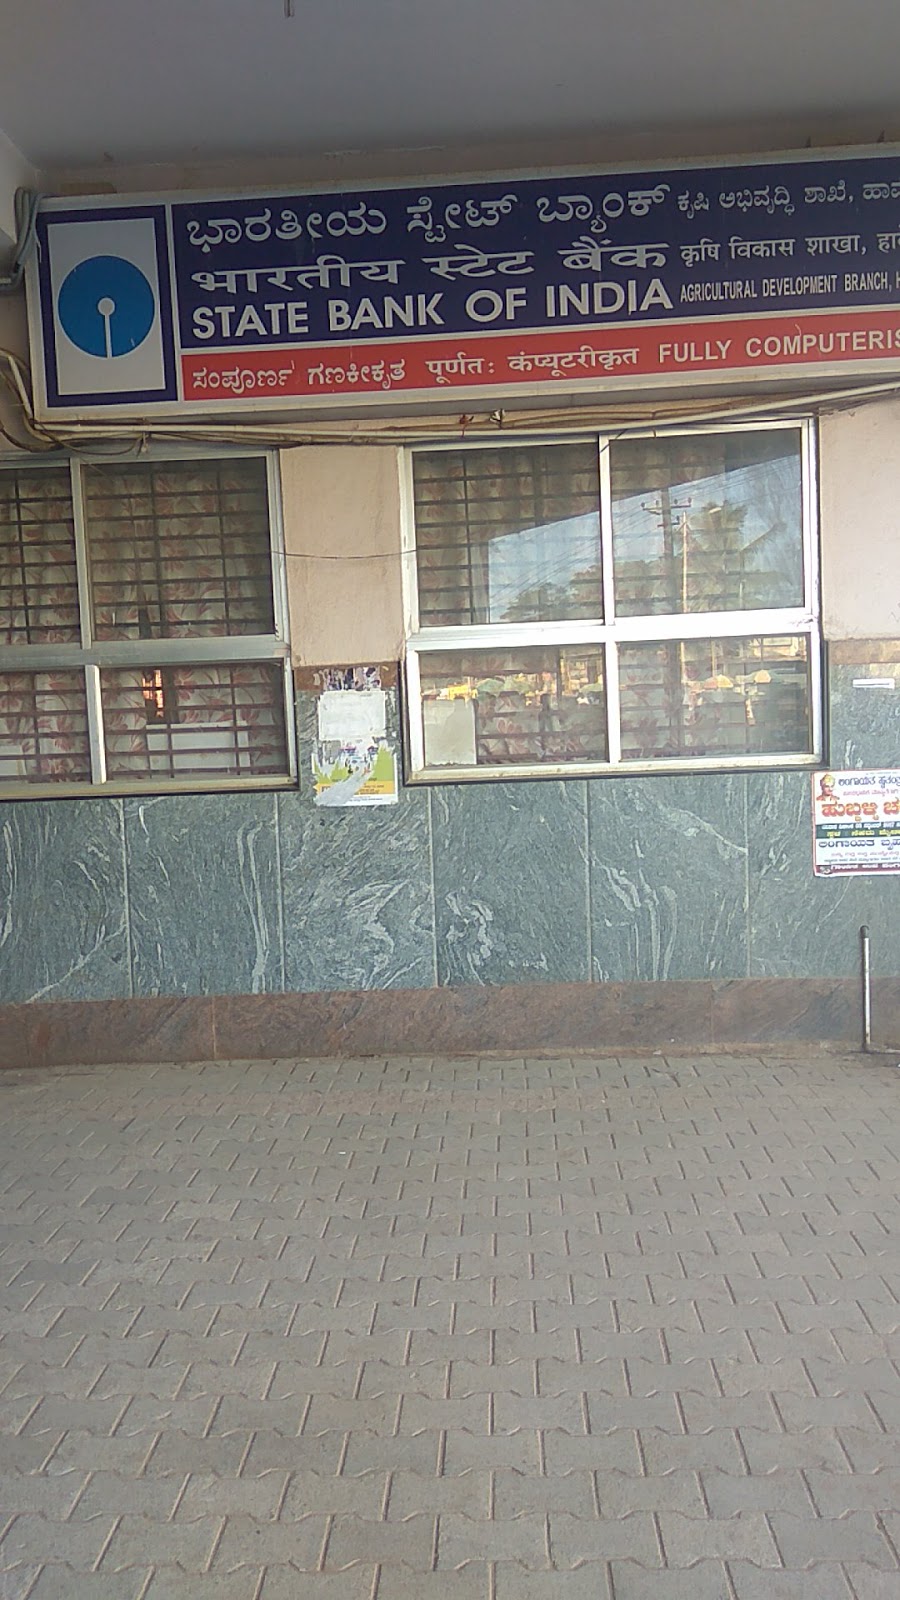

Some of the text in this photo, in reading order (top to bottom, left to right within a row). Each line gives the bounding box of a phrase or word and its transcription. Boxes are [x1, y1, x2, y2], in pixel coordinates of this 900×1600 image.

[187, 201, 387, 252] ಭಾರತೀಯ
[407, 194, 517, 243] ಸ್ಟೇಟ್
[537, 184, 670, 233] ಬ್ಯಾಂಕ್
[677, 190, 710, 219] ಕೃಷಿ
[719, 185, 795, 216] ಅಭಿವೃದ್ಧಿ
[191, 254, 406, 294] भारतीय
[421, 243, 534, 280] स्टेट
[557, 235, 670, 271] बैंक
[680, 238, 721, 268] कृषि
[729, 236, 795, 259] विकास
[192, 301, 309, 339] STATE
[328, 292, 445, 332] BANK
[465, 286, 527, 323] OF
[546, 277, 674, 318] INDIA
[680, 280, 757, 303] AGRICULTURAL
[762, 274, 838, 297] DEVELOPMENT
[844, 271, 892, 293] BRANCH,
[507, 345, 639, 377] कंप्यूटरीकृत
[659, 339, 732, 364] FULLY
[192, 362, 295, 394] ಸಂಪೂರ್ಣ
